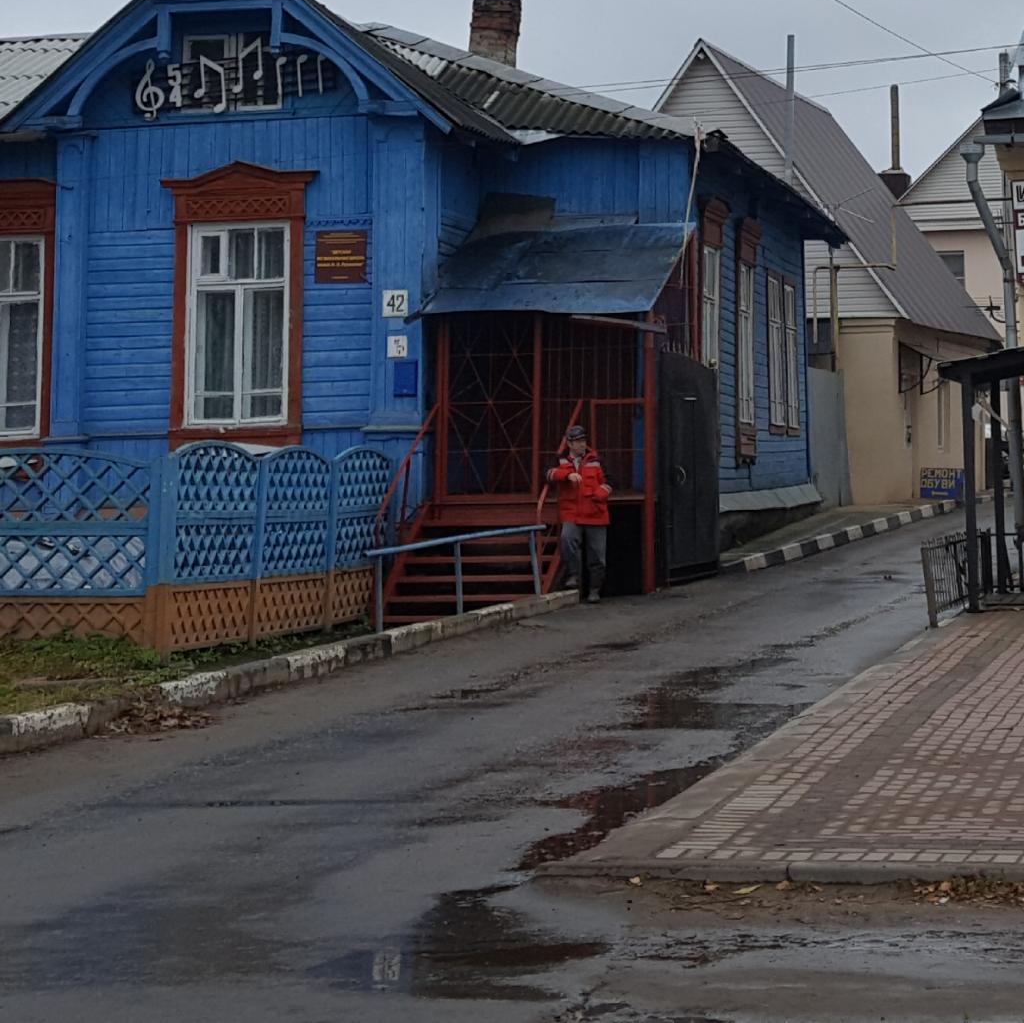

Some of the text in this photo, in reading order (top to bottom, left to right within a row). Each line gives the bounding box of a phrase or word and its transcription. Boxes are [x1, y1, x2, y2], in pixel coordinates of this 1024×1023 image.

[167, 64, 182, 86] 5
[169, 85, 182, 107] 4
[386, 294, 405, 313] 42
[921, 468, 963, 479] РЕМОНТ
[920, 478, 956, 489] ОБУВИ
